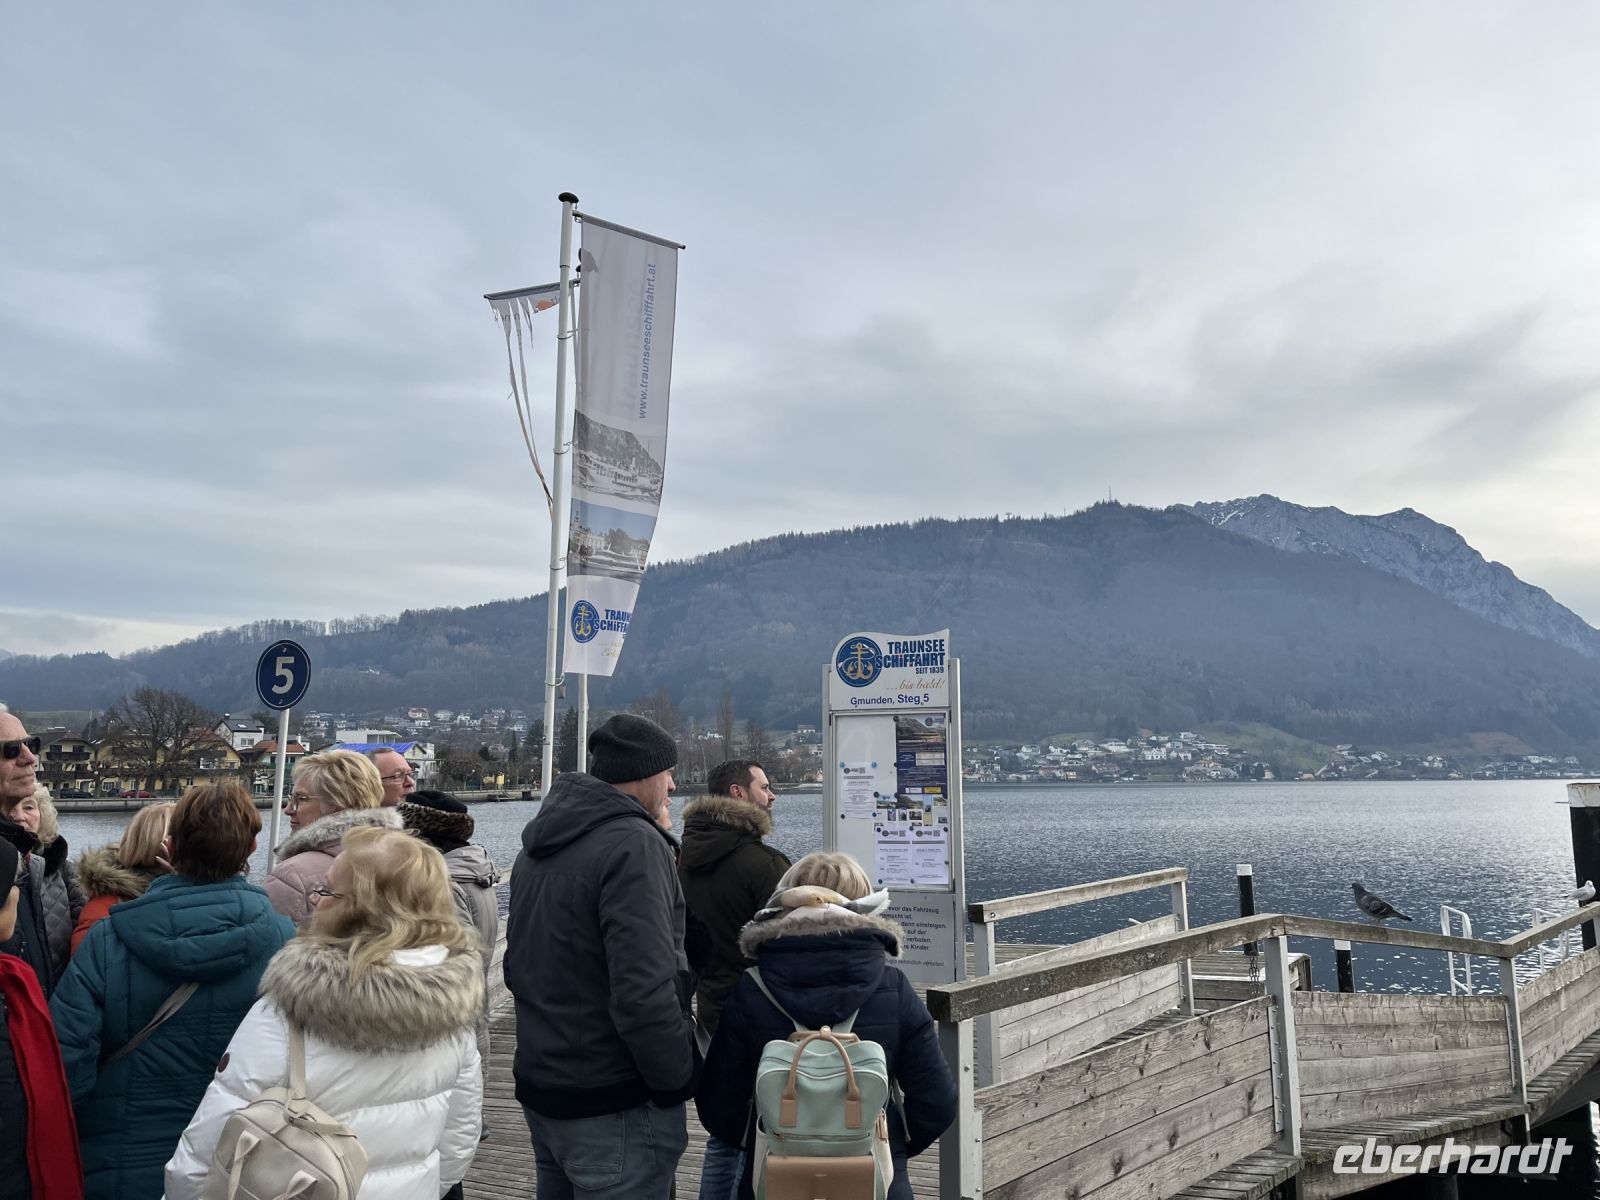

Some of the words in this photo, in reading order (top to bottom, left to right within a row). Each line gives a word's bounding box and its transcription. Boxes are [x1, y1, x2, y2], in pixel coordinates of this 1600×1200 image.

[887, 639, 945, 654] TRAUNSEE
[271, 656, 295, 695] 5
[915, 667, 928, 675] SEIT
[929, 666, 945, 674] 1839
[850, 696, 895, 706] Gmunden,
[897, 693, 920, 705] Steg
[923, 693, 930, 703] 5
[910, 943, 929, 951] Kinder
